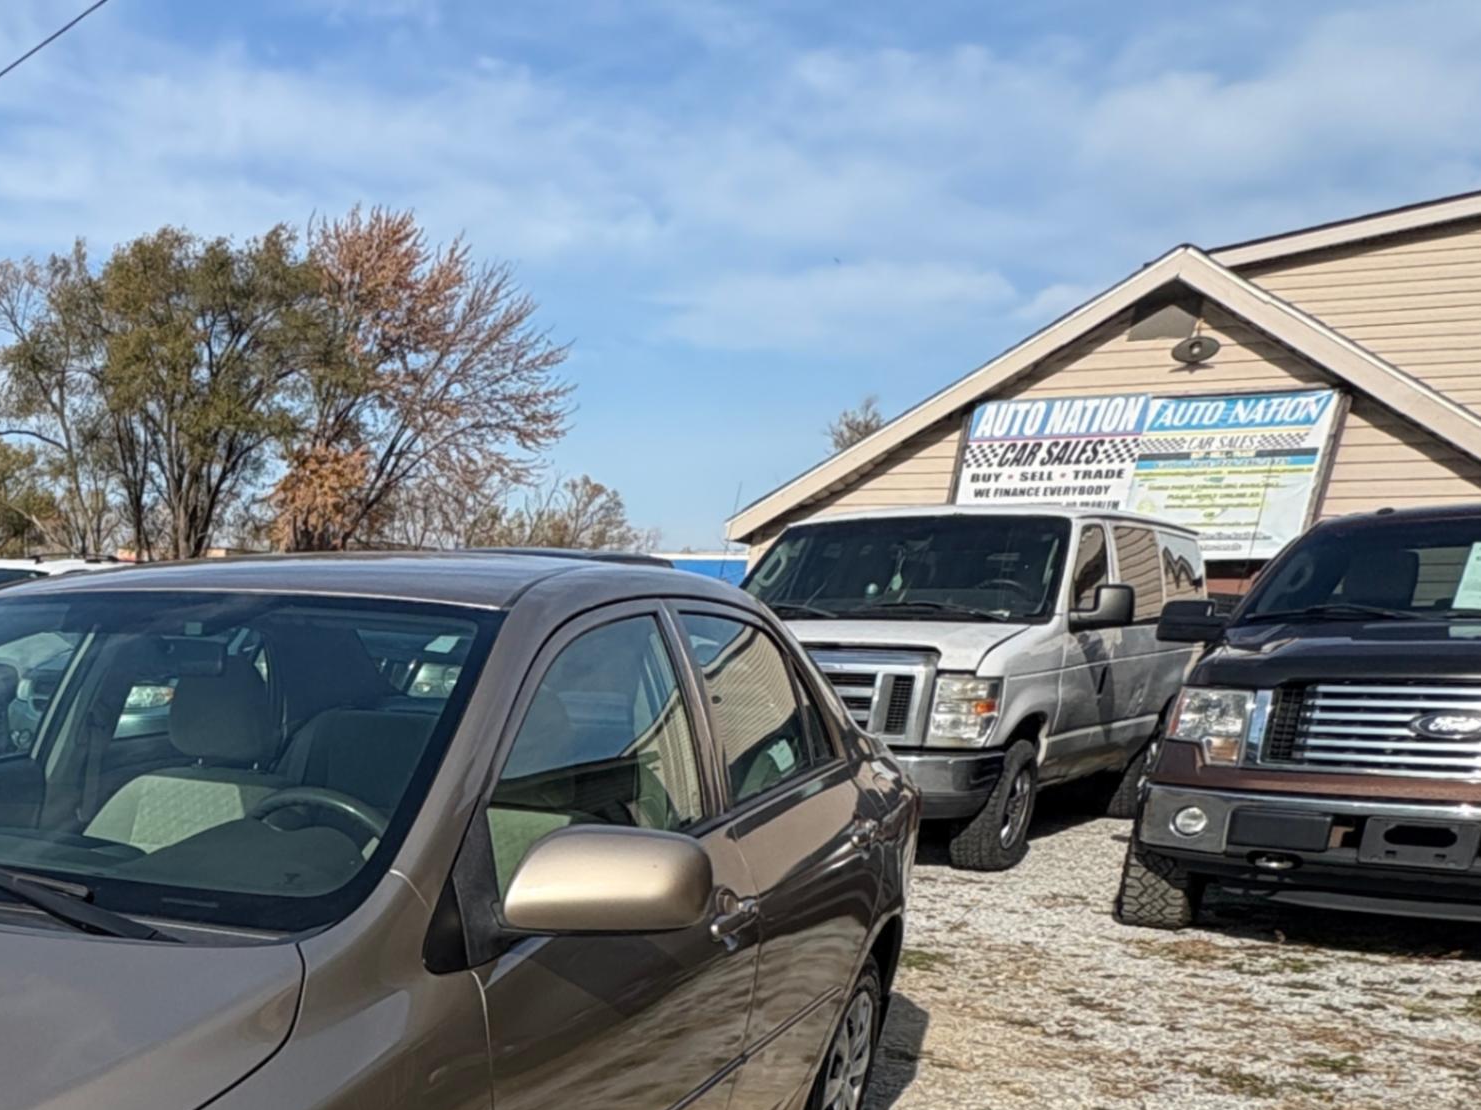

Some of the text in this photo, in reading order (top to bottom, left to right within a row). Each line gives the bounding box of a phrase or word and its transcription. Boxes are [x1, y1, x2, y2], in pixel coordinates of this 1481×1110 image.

[974, 396, 1146, 438] AUTO NATION
[1154, 395, 1327, 428] AUTO NATION
[1187, 434, 1257, 450] CAR SALES
[997, 439, 1105, 468] CAR SALES
[970, 472, 1003, 483] BUY
[1019, 471, 1054, 482] SELL
[1073, 468, 1126, 481] TRADE
[973, 484, 1112, 498] WE FINANCE EVERYBODY
[1428, 715, 1481, 732] Ford
